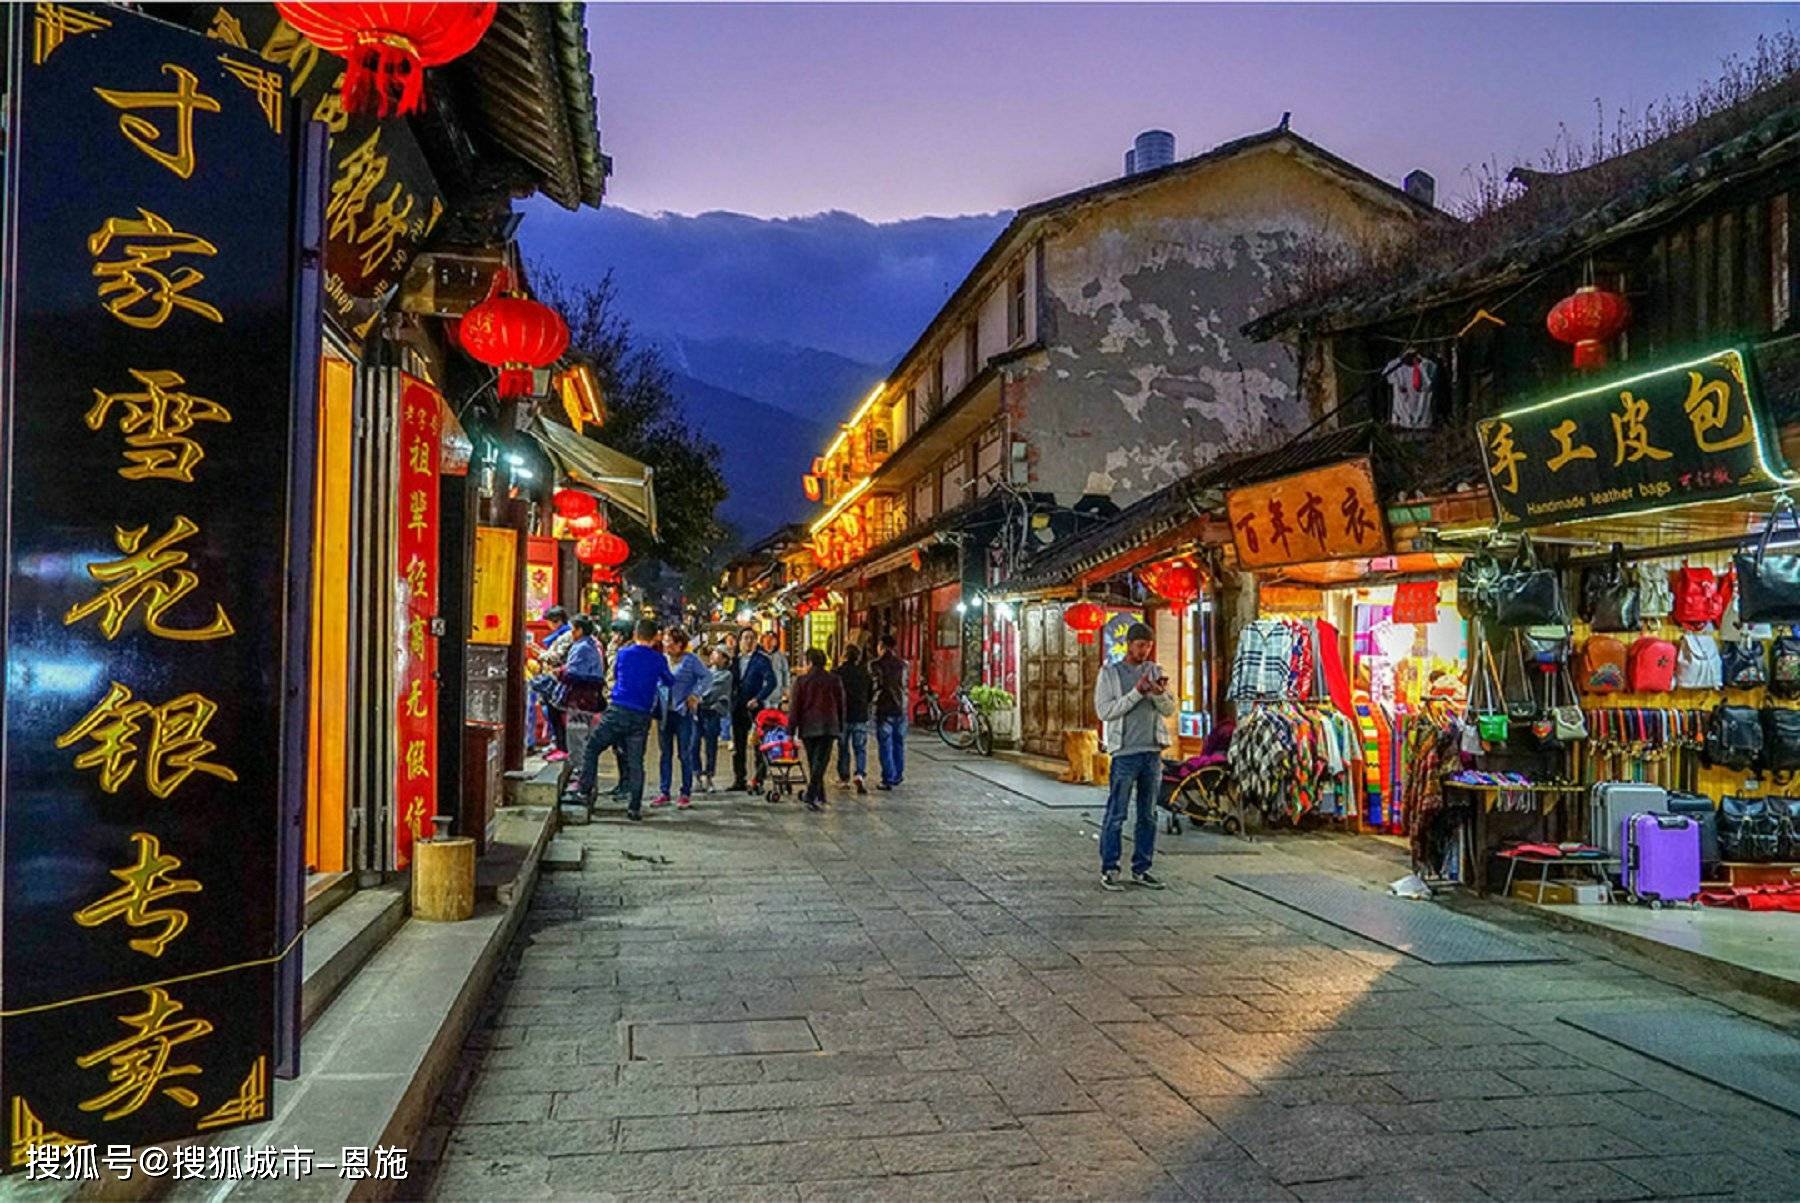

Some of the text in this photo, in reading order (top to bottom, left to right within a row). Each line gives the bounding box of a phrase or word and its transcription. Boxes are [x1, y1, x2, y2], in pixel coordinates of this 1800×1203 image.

[323, 268, 354, 315] Shop
[1489, 371, 1753, 494] 手工皮包
[1236, 487, 1376, 558] 百年布衣
[1526, 480, 1672, 515] Handmade leather bags
[56, 63, 238, 1121] 寸家雪花银专卖
